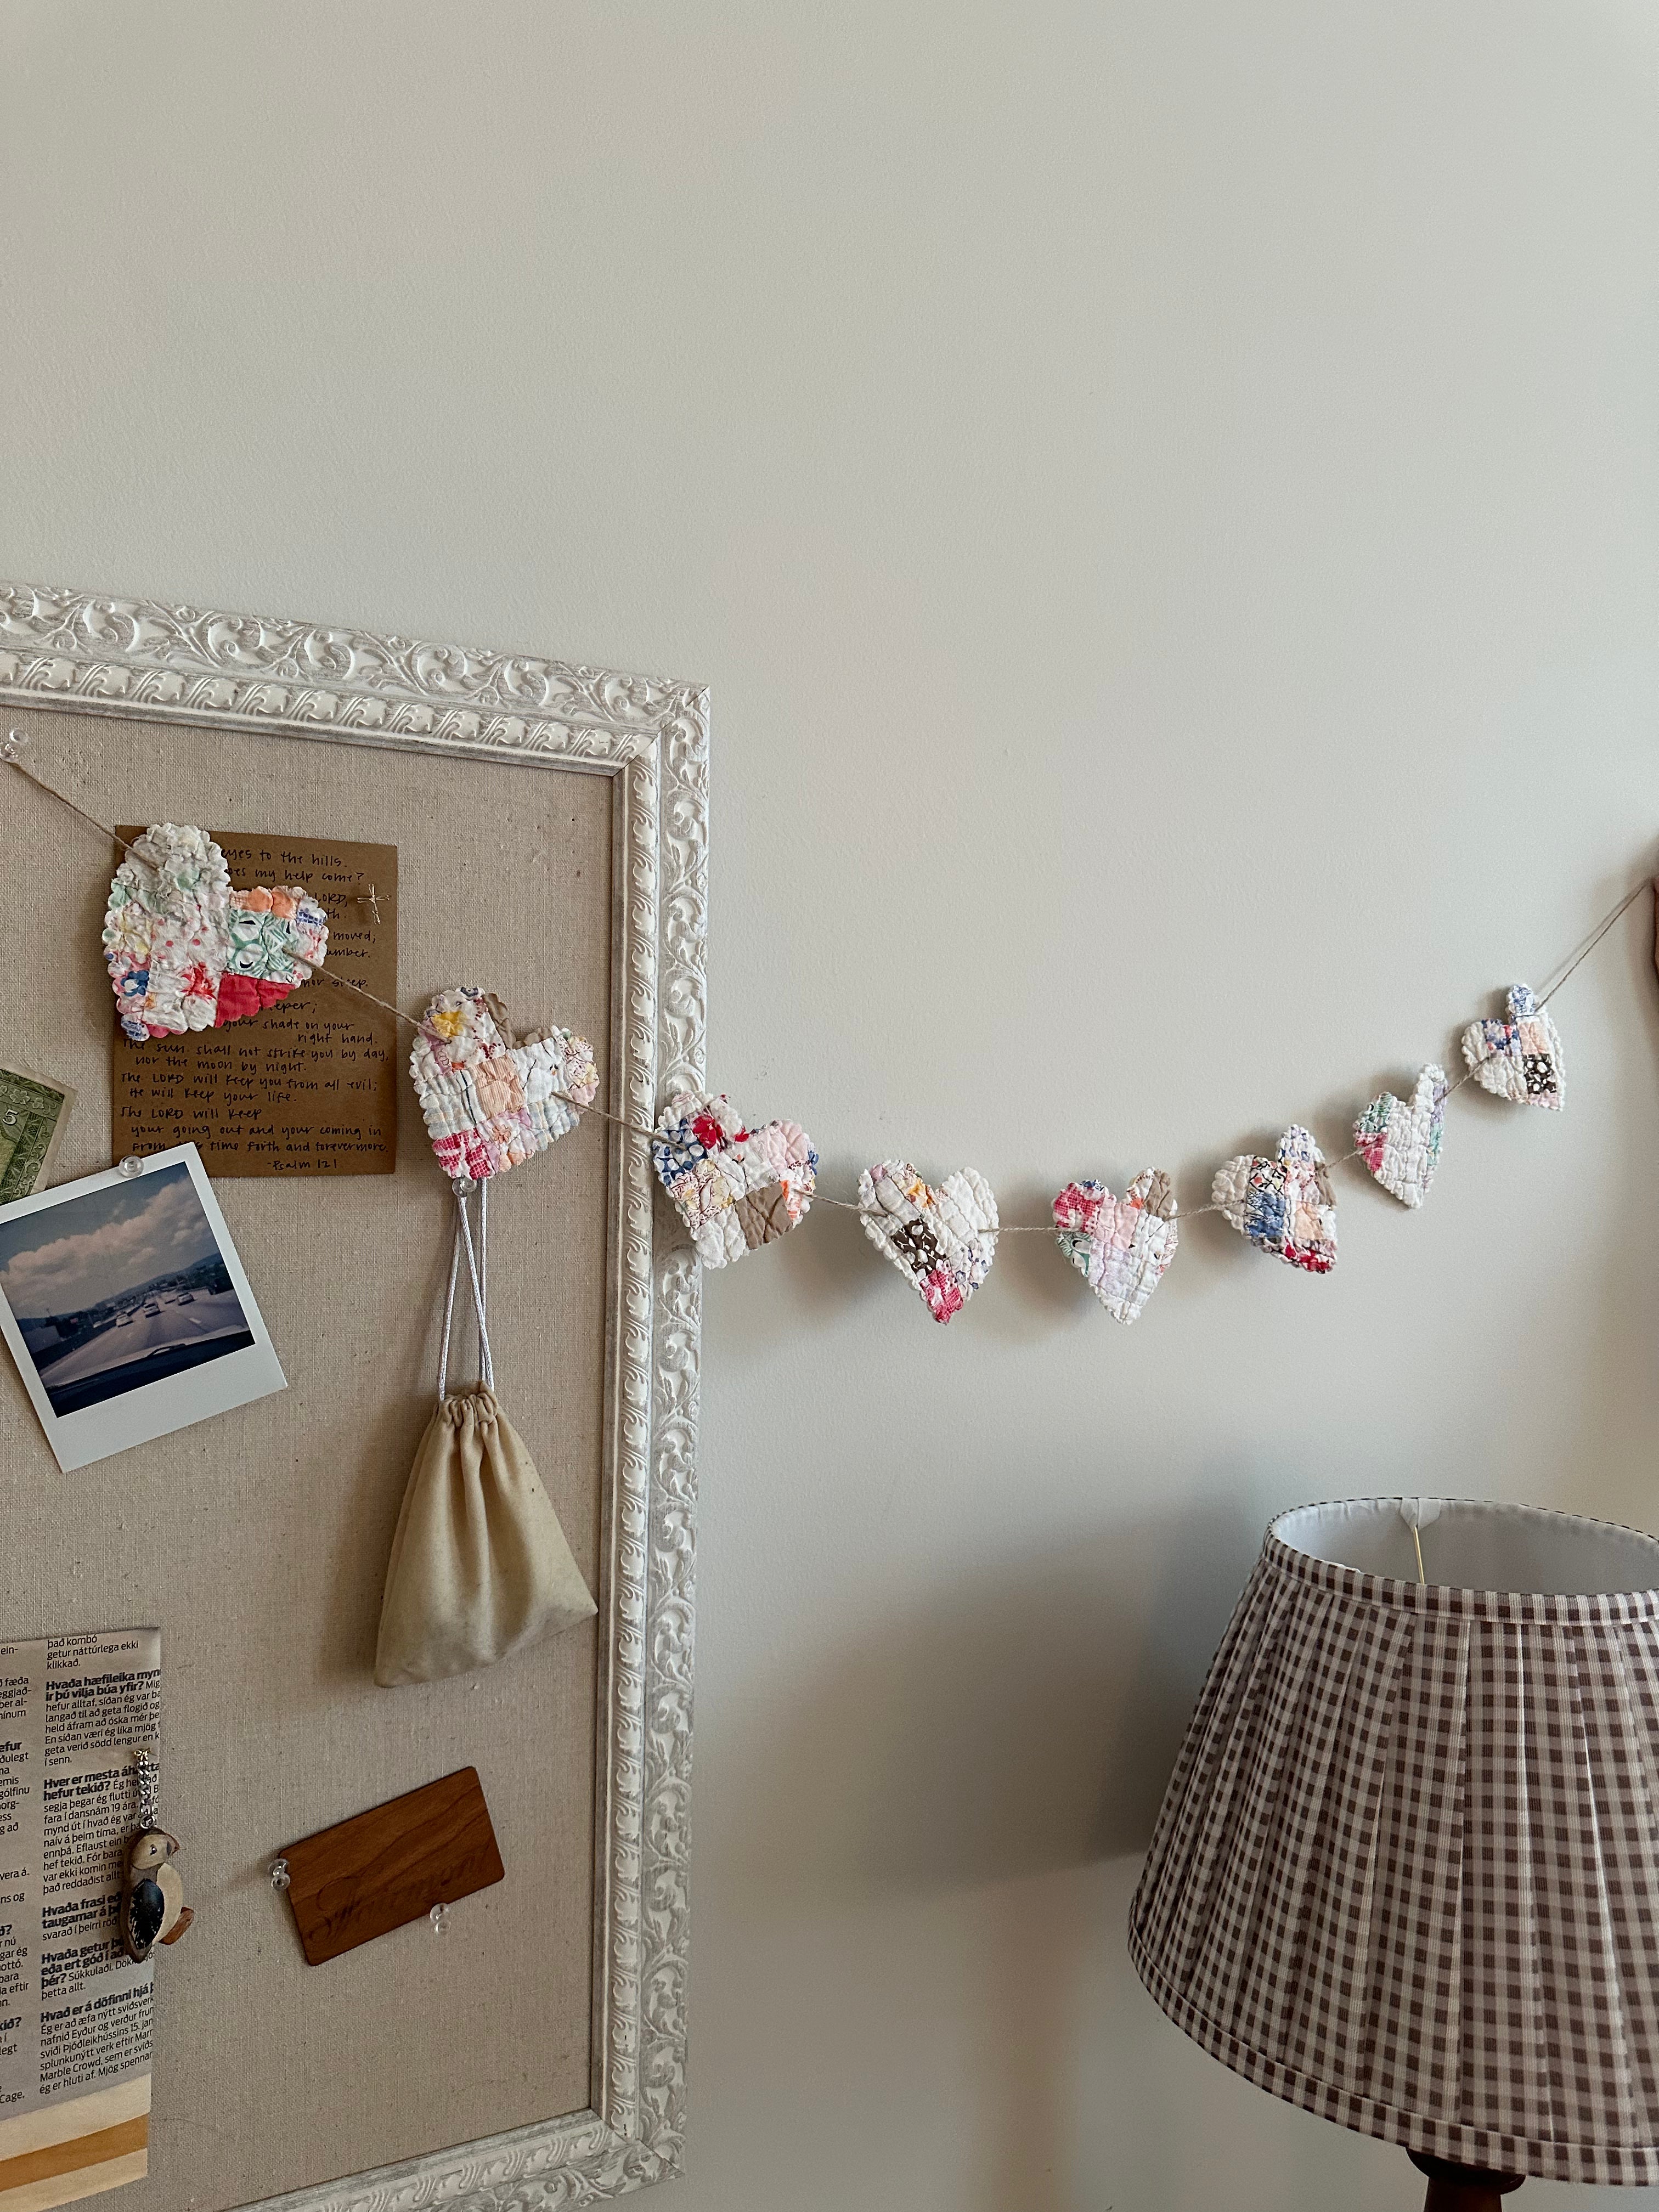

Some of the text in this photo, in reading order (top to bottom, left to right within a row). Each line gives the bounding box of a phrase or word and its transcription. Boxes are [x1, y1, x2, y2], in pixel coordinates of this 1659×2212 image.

[221, 849, 347, 867] eyes to the hills.
[224, 868, 364, 884] oes my help come?
[334, 931, 376, 944] moved;
[326, 948, 370, 958] umber.
[261, 1001, 317, 1013] eper;
[263, 1019, 300, 1029] shade
[324, 1022, 354, 1034] your
[298, 1032, 377, 1045] right hand.
[123, 1039, 388, 1062] The sun shall not strike you by day,
[136, 1056, 306, 1075] nor the moon by night.
[122, 1072, 140, 1082] The
[153, 1074, 184, 1084] LORD
[193, 1073, 218, 1084] will
[259, 1078, 281, 1089] you
[286, 1078, 318, 1090] from
[325, 1079, 339, 1090] all
[347, 1079, 377, 1091] evil;
[130, 1088, 144, 1098] He
[151, 1087, 173, 1098] will
[223, 1092, 258, 1106] your
[268, 1091, 296, 1103] life.
[2, 1109, 19, 1125] 5
[122, 1106, 141, 1118] The
[151, 1108, 183, 1119] LORD
[193, 1108, 218, 1119] will
[131, 1124, 381, 1140] your going out and your coming in
[210, 1140, 239, 1150] time
[247, 1141, 279, 1152] forth
[286, 1142, 310, 1152] and
[316, 1142, 388, 1152] forevermore.
[318, 1159, 336, 1169] 121
[1, 1646, 18, 1655] ein-
[47, 1640, 138, 1660] getur náttúrlega ekki
[48, 1634, 97, 1650] það kombó
[47, 1658, 81, 1669] klikkað.
[5, 1677, 29, 1686] fæða
[46, 1672, 135, 1690] Hvaða hæfileika
[46, 1680, 160, 1701] ir þú vilja búa yfir? Mig
[46, 1703, 70, 1712] hefur
[72, 1700, 97, 1708] alltaf,
[99, 1696, 122, 1705] síðan
[124, 1695, 134, 1703] ég
[46, 1711, 76, 1722] langað
[101, 1706, 121, 1717] geta
[124, 1702, 148, 1713] flogið
[150, 1701, 159, 1709] og
[46, 1713, 147, 1734] held áfram að óska mér
[46, 1723, 156, 1744] En síðan væri ég líka mjög
[45, 1746, 65, 1757] geta
[67, 1742, 88, 1752] verið
[91, 1739, 111, 1748] södd
[114, 1735, 141, 1745] lengur
[49, 1757, 72, 1765] senn.
[44, 1769, 119, 1790] Hver er mesta
[43, 1778, 124, 1801] hefur tekið? Ég
[44, 1815, 62, 1824] fara
[69, 1807, 109, 1819] dansnám
[111, 1803, 120, 1812] 19
[122, 1801, 138, 1810] ára.
[7, 1822, 19, 1832] að
[13, 1893, 25, 1901] og
[16, 1946, 27, 1956] ég
[9, 1982, 29, 1993] eftir
[41, 1982, 86, 2001] þetta allt.
[41, 2024, 52, 2035] Ég
[65, 2018, 76, 2028] að
[78, 2015, 95, 2025] æfa
[98, 2008, 116, 2019] nýtt
[41, 2013, 137, 2047] nafnið Eyður og verður
[41, 2045, 60, 2058] sviði
[131, 2023, 140, 2032] 15.
[40, 2036, 133, 2071] splunkunýtt verk eftir
[40, 2067, 71, 2082] Marble
[105, 2053, 122, 2063] sem
[124, 2049, 133, 2057] er
[40, 2064, 119, 2094] ég er hluti af. Mjög
